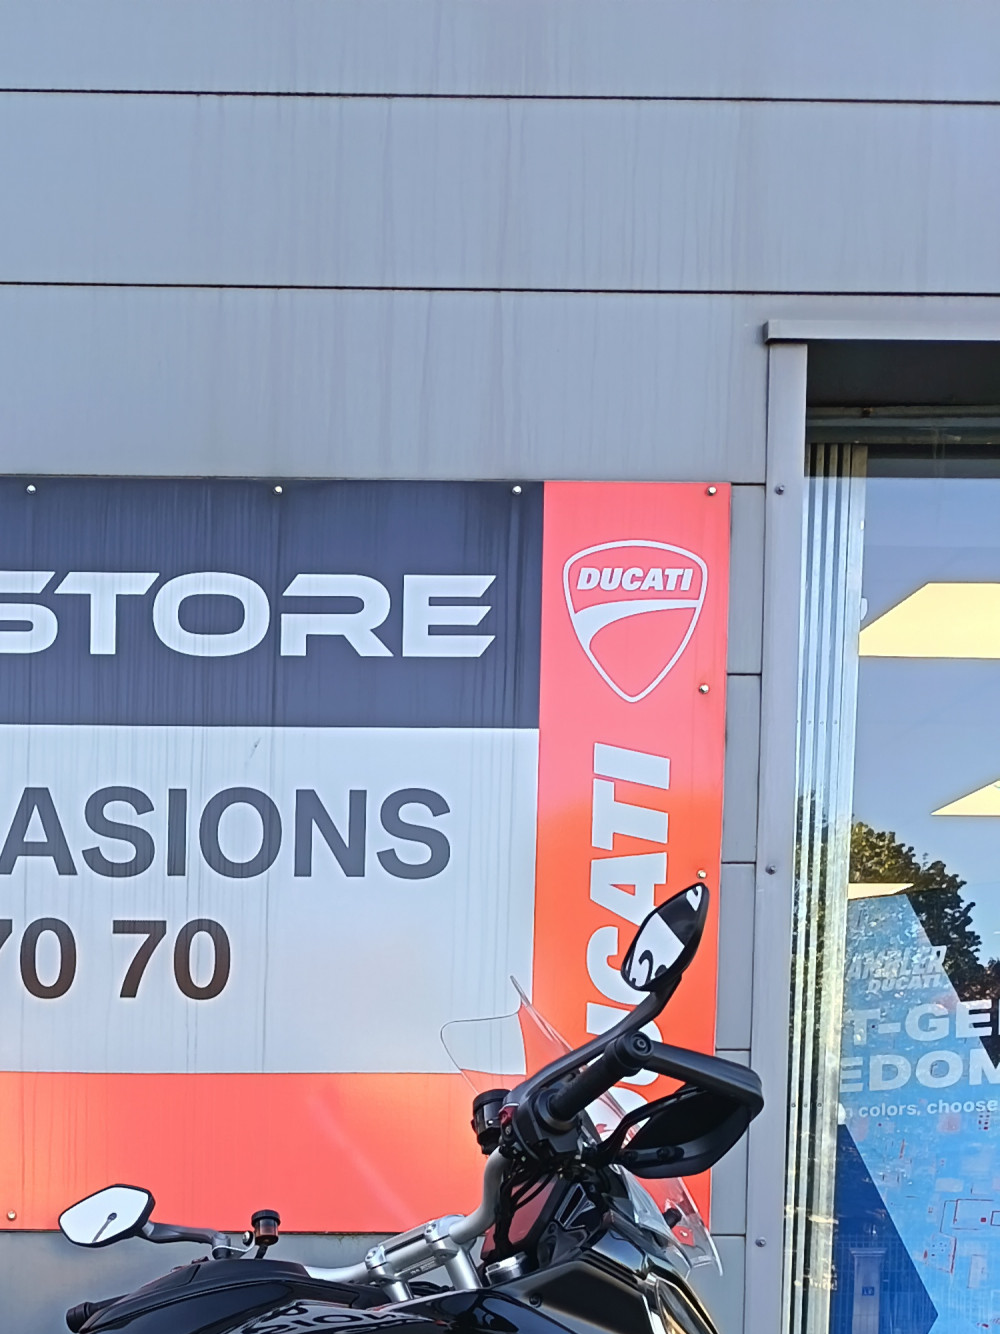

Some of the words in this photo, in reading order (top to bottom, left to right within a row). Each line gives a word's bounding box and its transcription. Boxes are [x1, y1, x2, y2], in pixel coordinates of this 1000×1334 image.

[577, 567, 693, 591] DUCATI
[113, 918, 231, 1001] 70
[859, 1102, 921, 1118] colors,
[927, 1099, 999, 1115] choose
